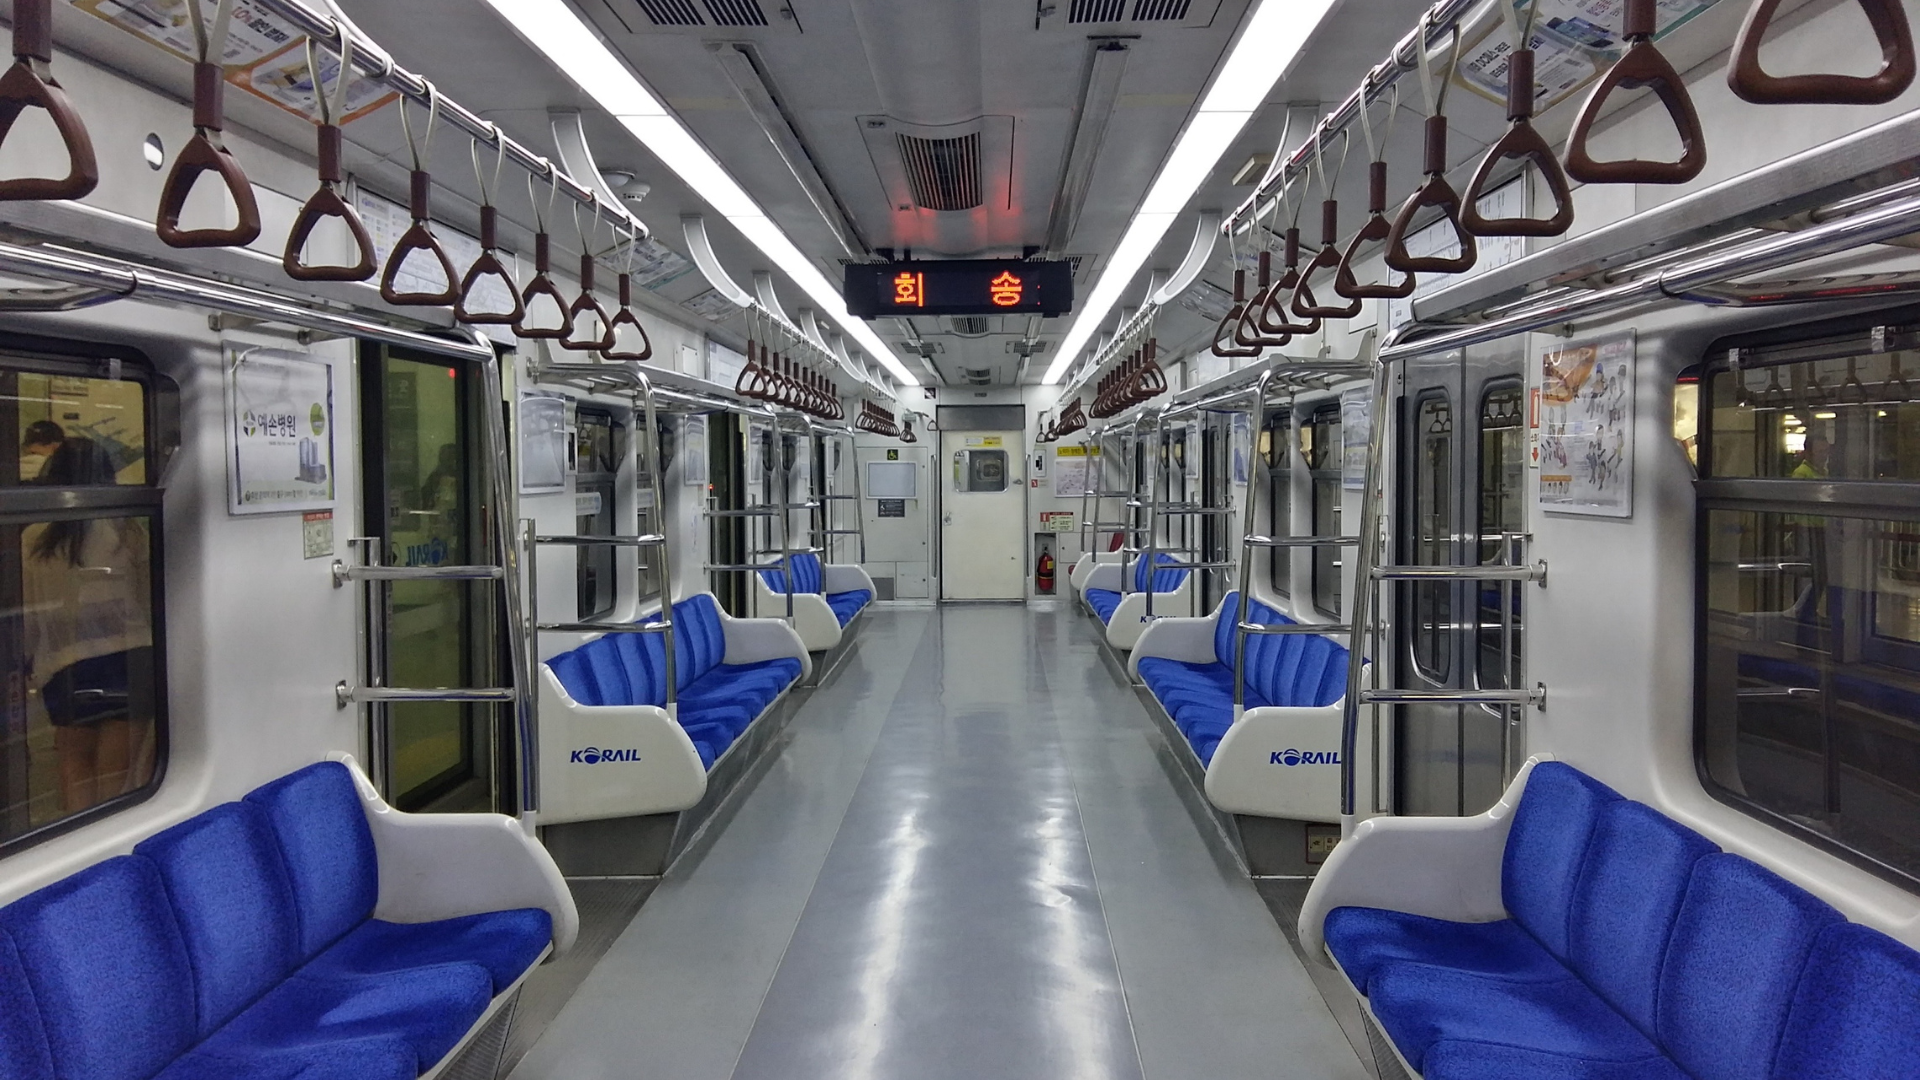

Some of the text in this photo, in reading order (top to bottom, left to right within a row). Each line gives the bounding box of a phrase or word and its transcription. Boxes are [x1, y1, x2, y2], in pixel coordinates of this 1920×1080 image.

[894, 270, 1023, 307] 회 송
[257, 413, 296, 438] 예손병원
[570, 746, 642, 765] KORAIL
[1269, 748, 1342, 767] KORAIL
